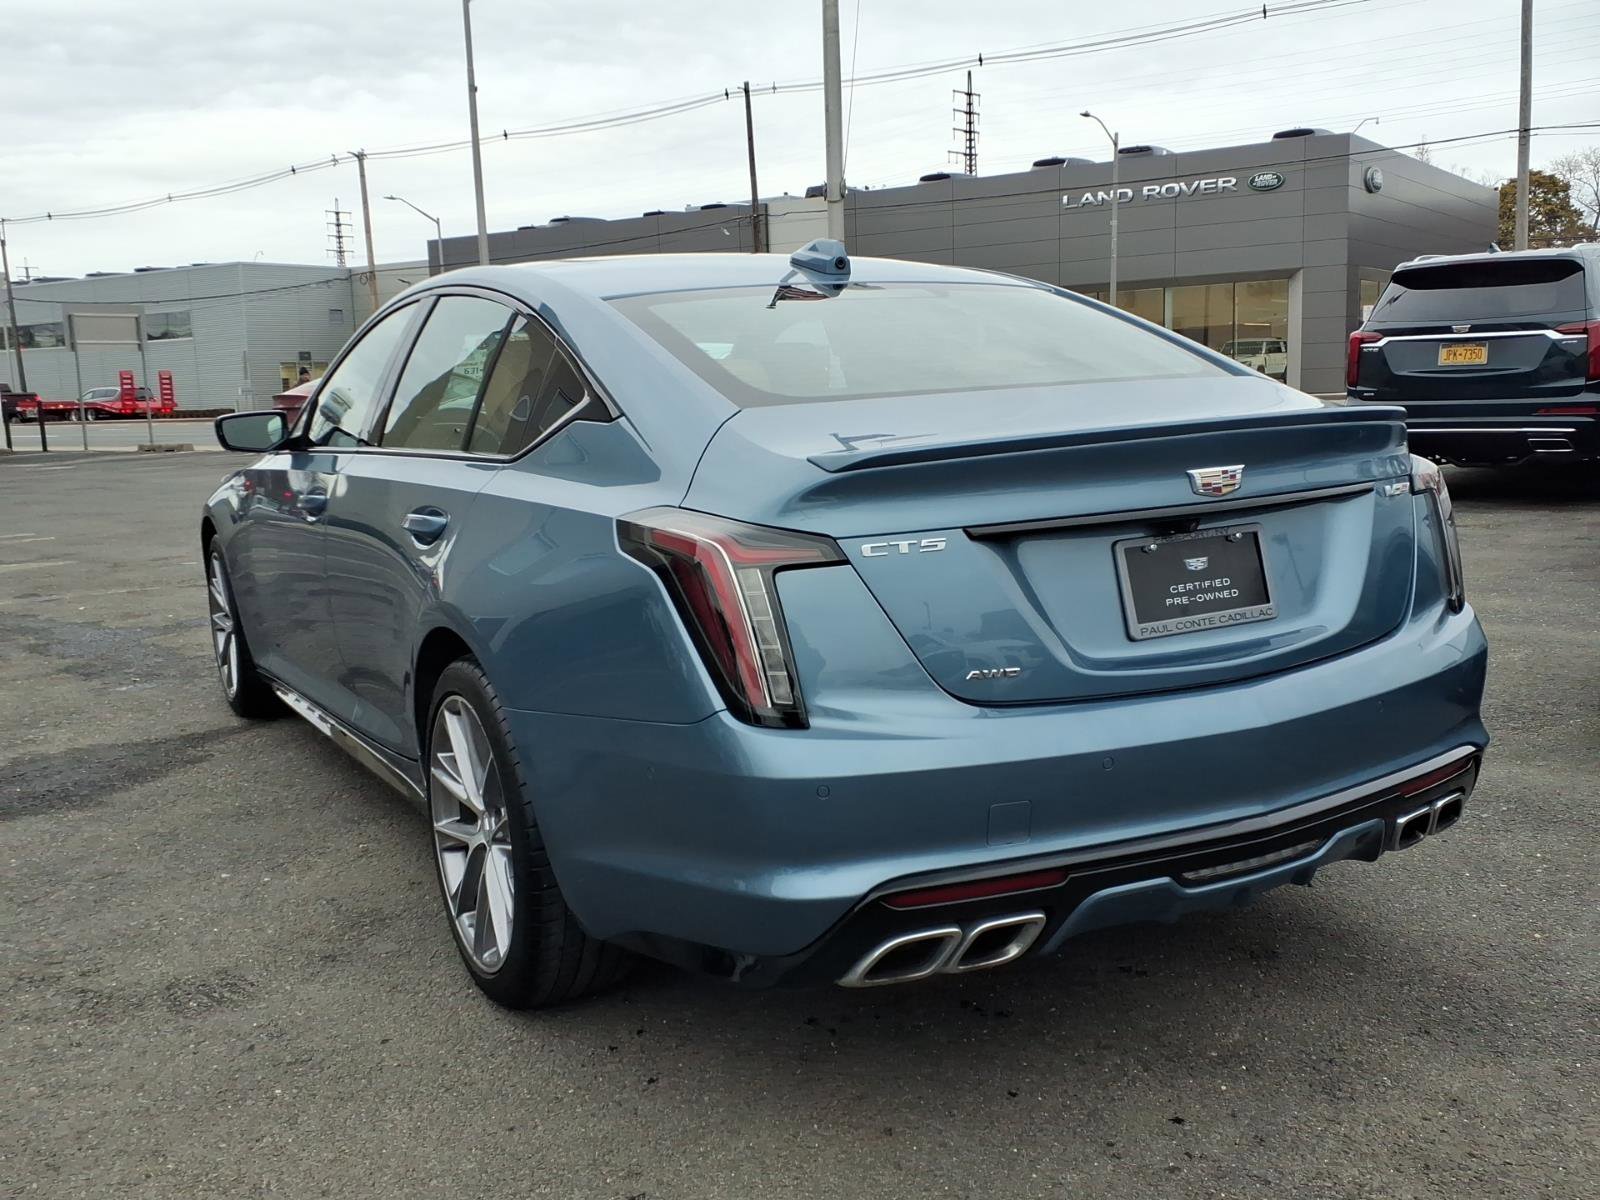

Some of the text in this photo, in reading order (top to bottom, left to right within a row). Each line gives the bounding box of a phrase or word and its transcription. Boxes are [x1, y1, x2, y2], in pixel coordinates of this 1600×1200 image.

[1062, 176, 1238, 209] LAND ROVER
[1443, 348, 1483, 361] JPK-7350
[861, 538, 946, 557] CT5
[1170, 577, 1231, 594] CERTIFIED
[1165, 588, 1239, 607] PRE-OWNED
[1140, 607, 1274, 637] PAUL CONTE CADILLAC
[965, 667, 1021, 681] AWD
